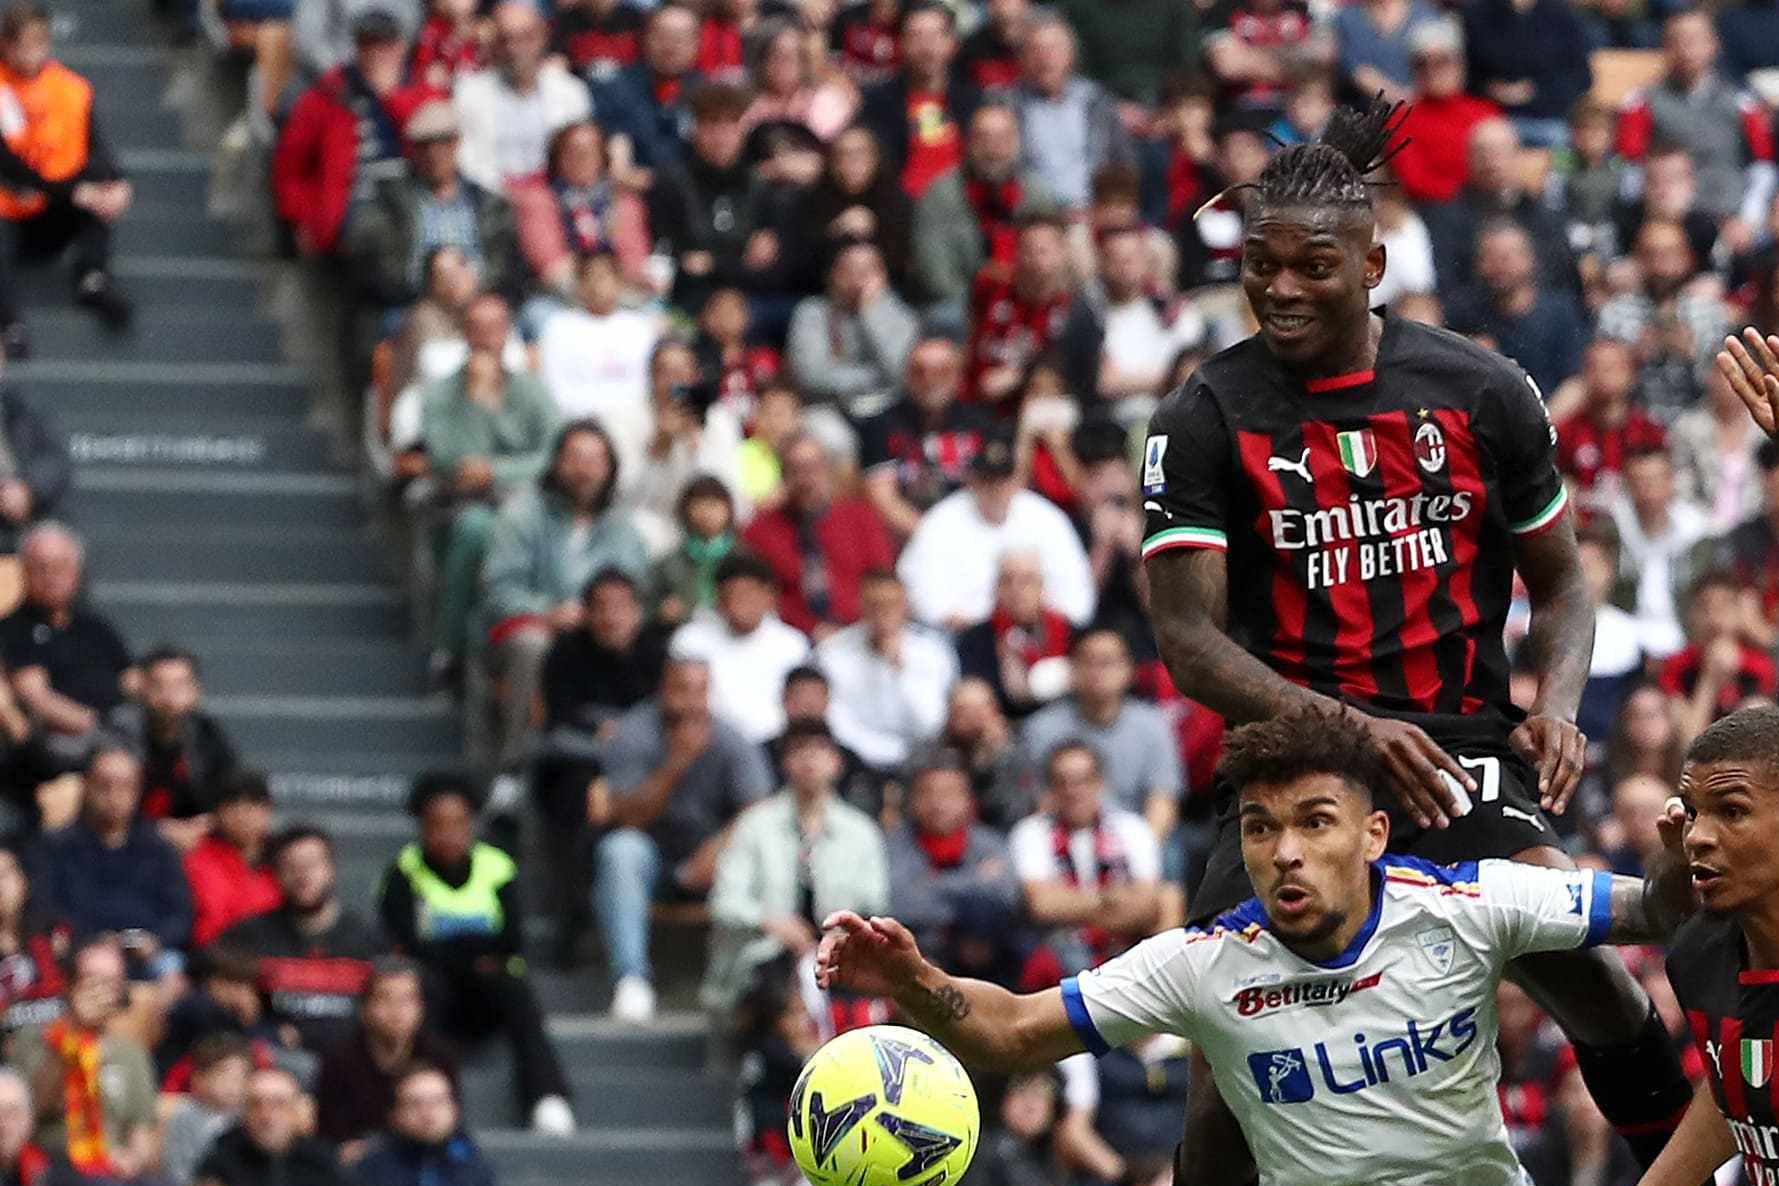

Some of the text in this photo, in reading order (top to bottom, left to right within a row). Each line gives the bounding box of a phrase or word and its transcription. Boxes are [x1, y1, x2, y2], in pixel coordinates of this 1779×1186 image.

[1267, 489, 1472, 550] Emirates
[1307, 528, 1448, 590] FLY BETTER
[1315, 1006, 1478, 1095] Links
